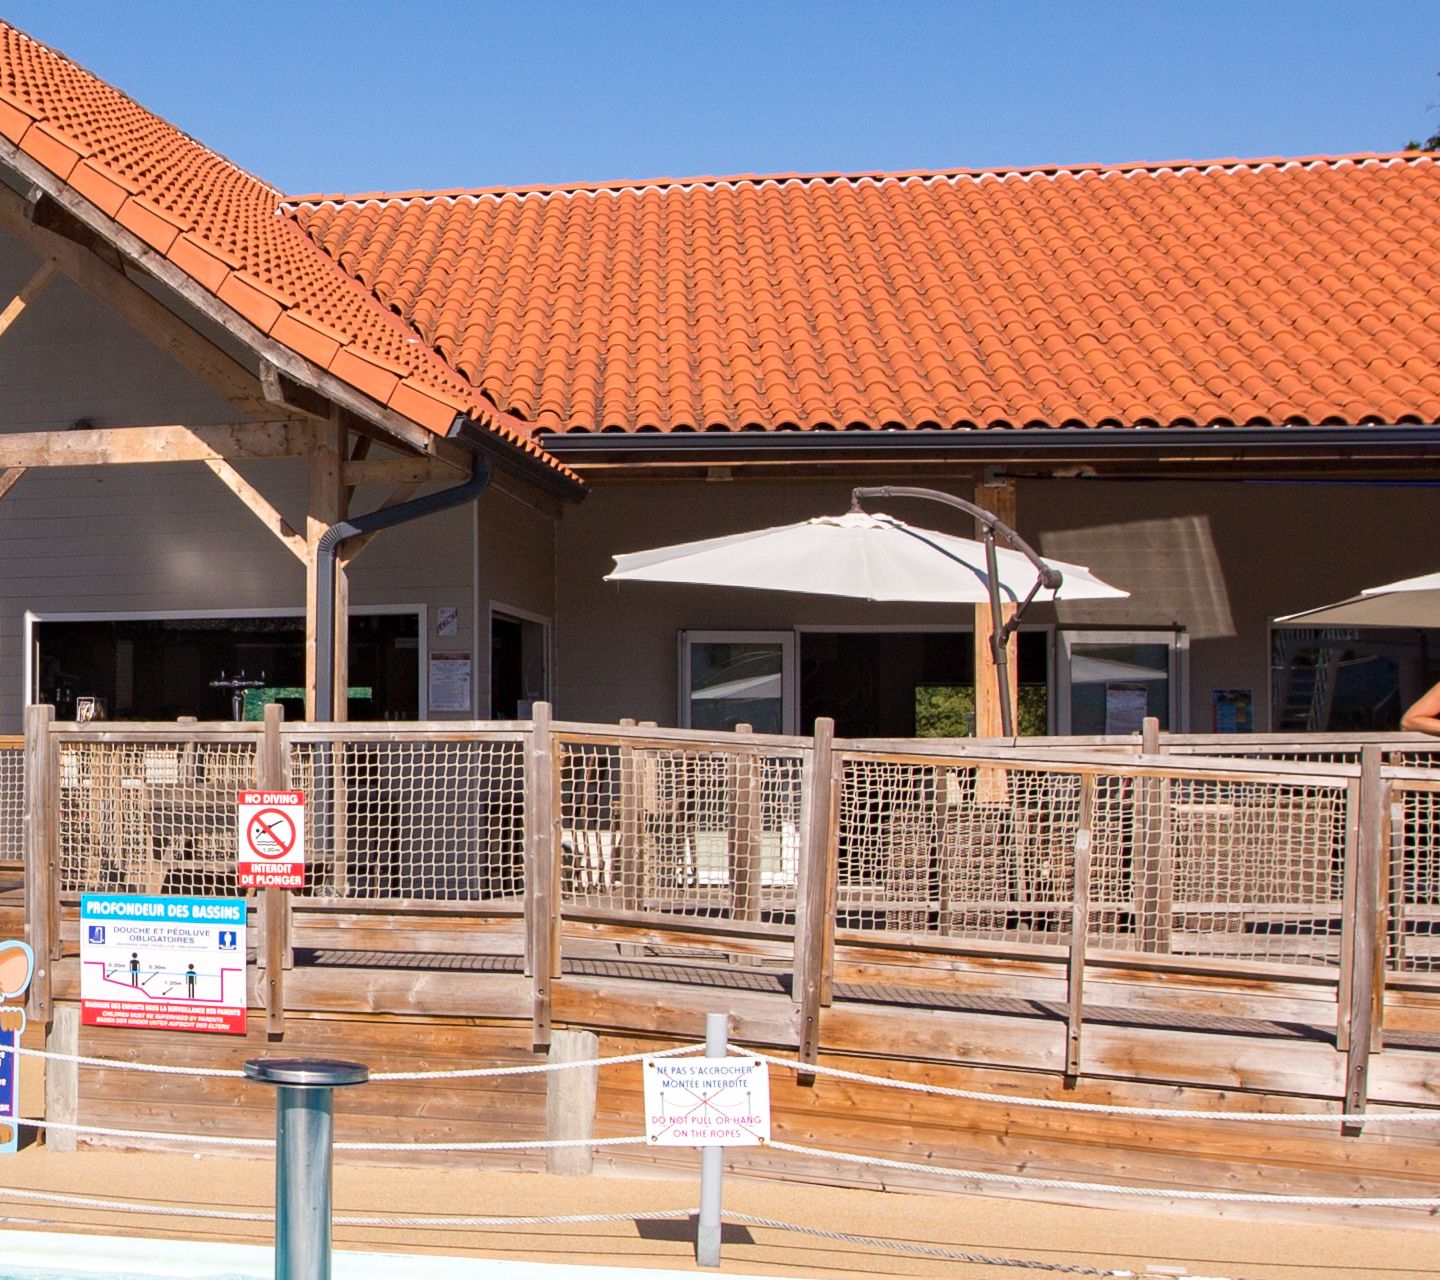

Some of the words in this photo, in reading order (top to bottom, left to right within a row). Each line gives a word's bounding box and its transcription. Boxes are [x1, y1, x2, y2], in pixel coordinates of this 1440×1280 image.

[245, 793, 261, 804] NO
[263, 794, 298, 804] DIVING
[251, 863, 292, 874] INTERDIT
[242, 875, 254, 885] DE
[256, 875, 302, 885] PLONGER
[86, 901, 165, 917] PROFONDEUR
[167, 904, 189, 918] DES
[192, 906, 240, 920] BASSINS
[113, 926, 151, 936] DOUCHE
[153, 927, 164, 935] ET
[167, 926, 210, 937] PÉDILUVE
[129, 934, 195, 944] OBLIGATOIRES
[657, 1066, 667, 1075] NE
[671, 1066, 687, 1075] PAS
[690, 1066, 752, 1075] S'ACCROCHER
[702, 1079, 748, 1088] INTERDITE
[652, 1115, 666, 1125] DO
[669, 1116, 688, 1125] NOT
[691, 1116, 712, 1125] PULL
[715, 1116, 730, 1125] OR
[733, 1115, 762, 1125] HANG
[673, 1129, 688, 1138] ON
[691, 1129, 707, 1138] THE
[710, 1129, 741, 1138] ROPES
